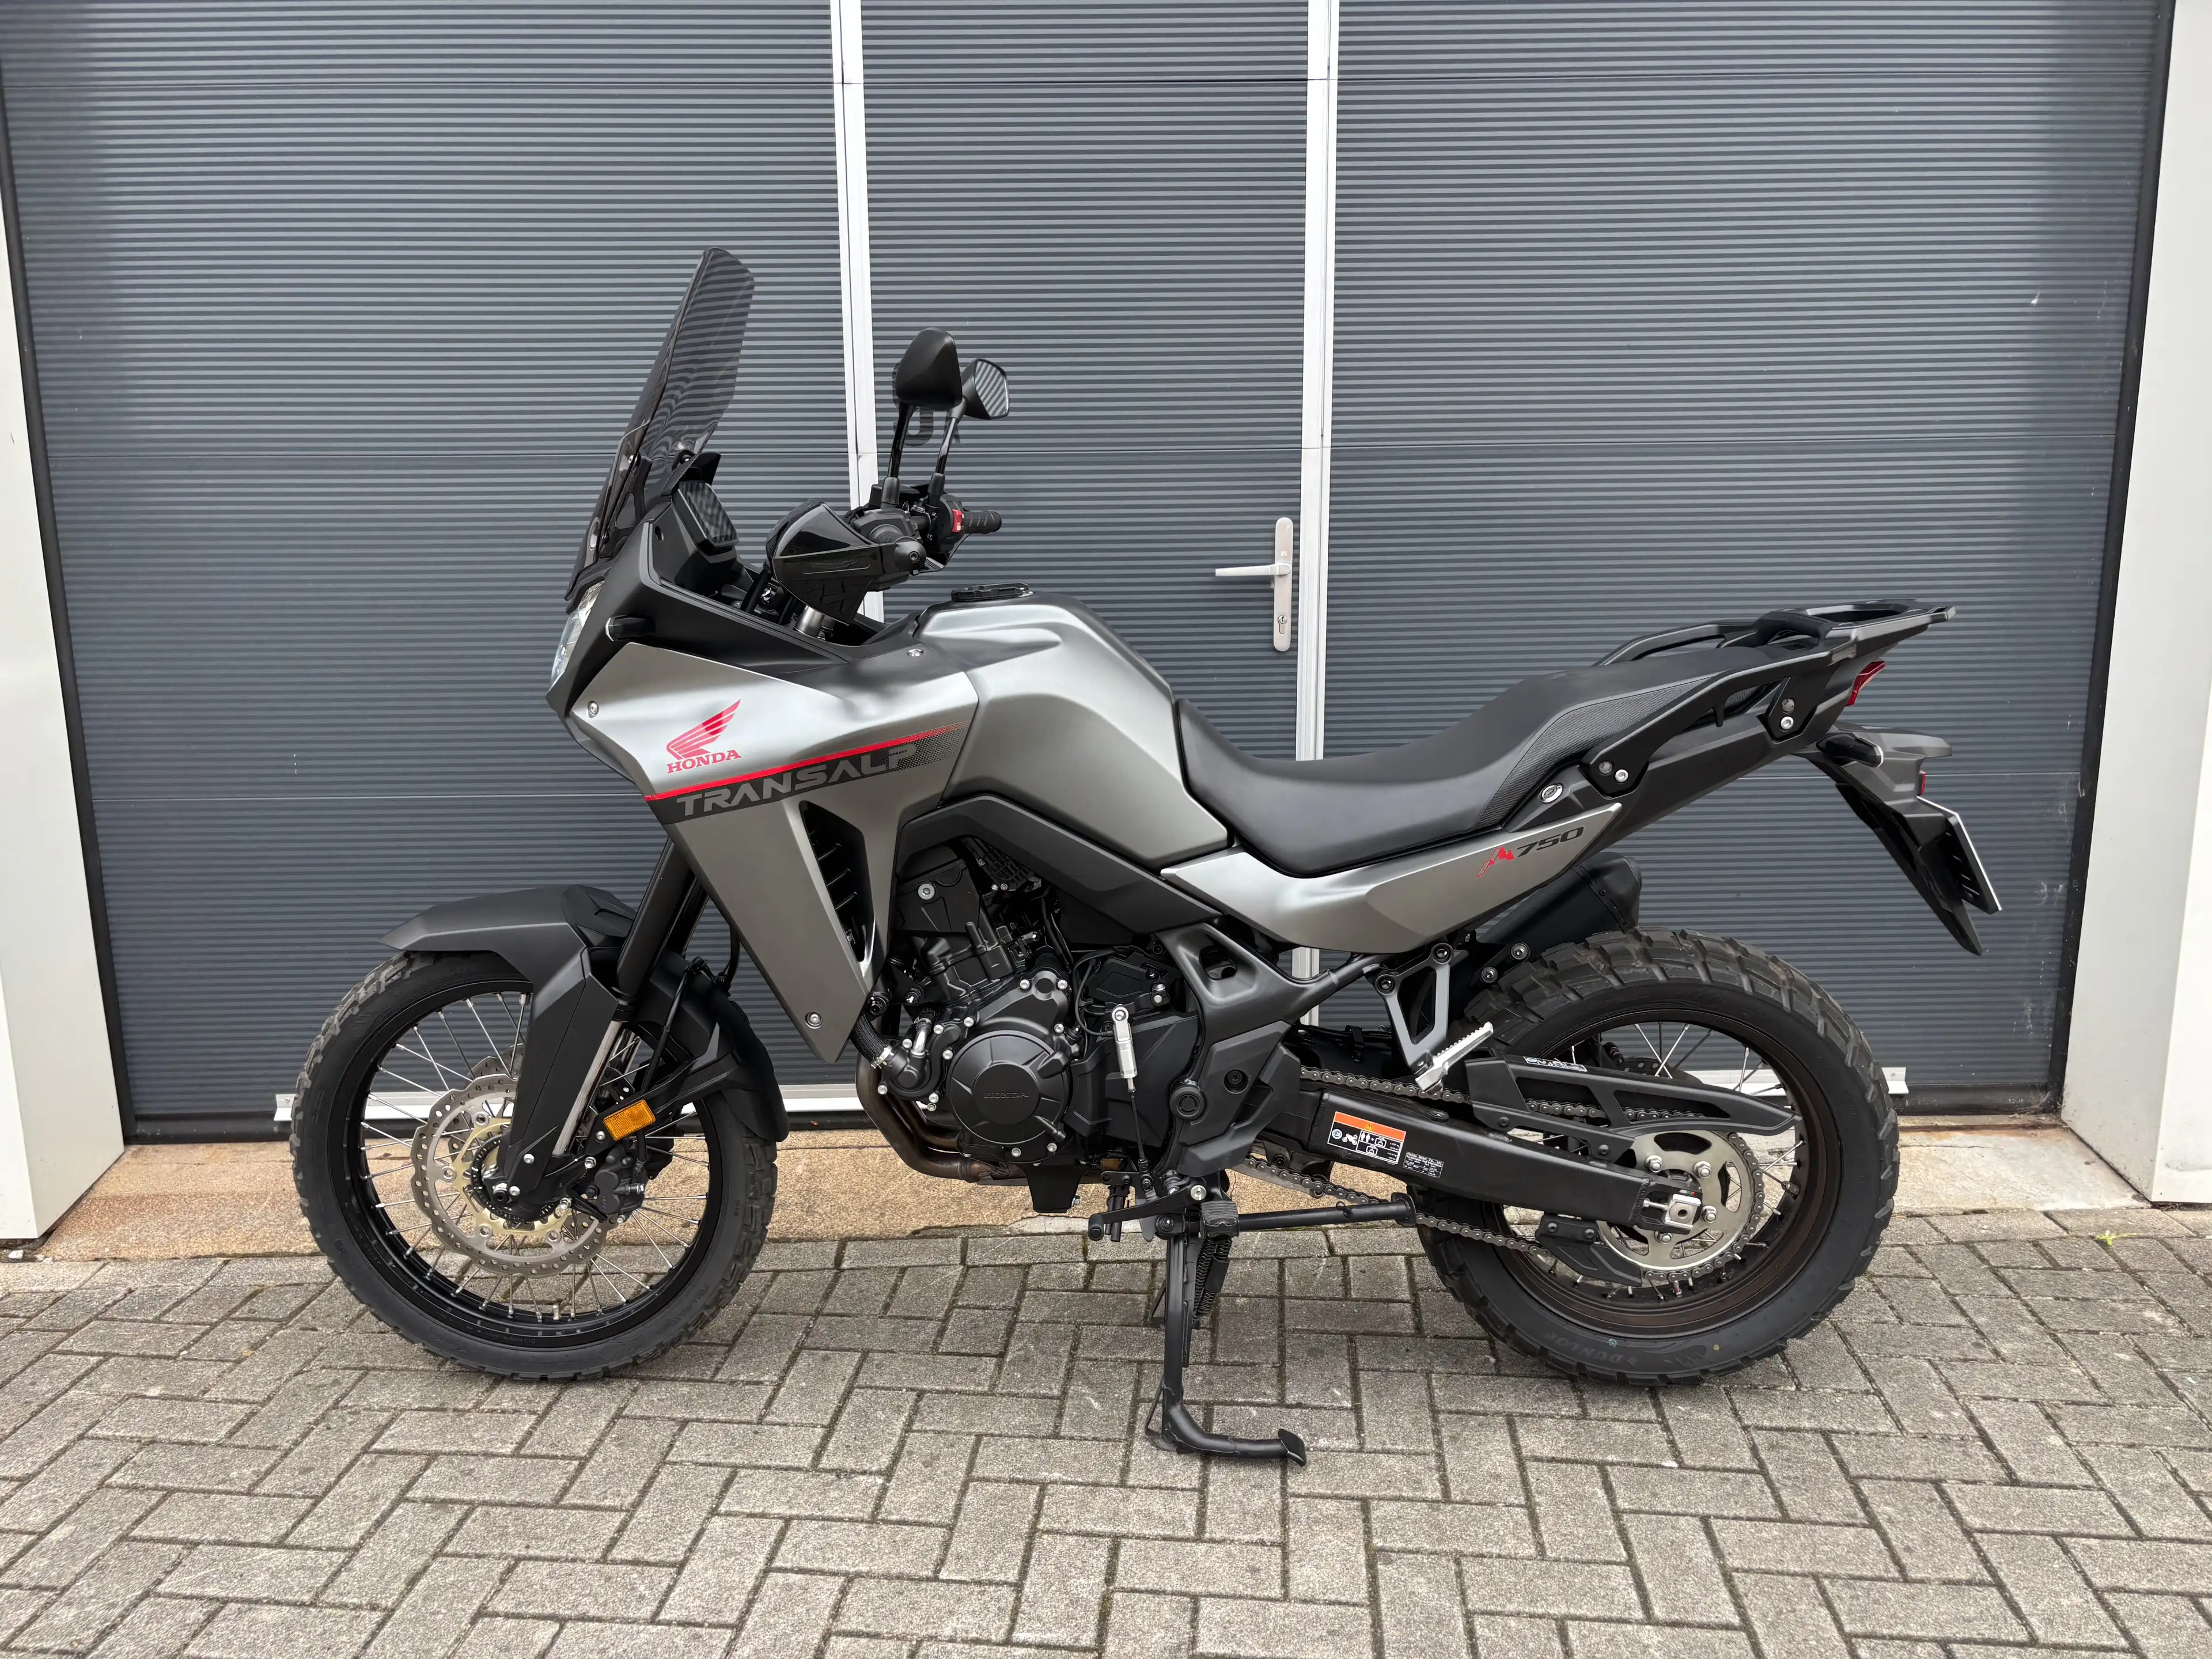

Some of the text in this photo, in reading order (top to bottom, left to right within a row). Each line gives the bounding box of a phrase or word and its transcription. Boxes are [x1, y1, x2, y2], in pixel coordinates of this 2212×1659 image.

[666, 749, 742, 774] HONDA
[676, 744, 916, 816] TRANSALP
[1517, 827, 1584, 857] 750
[1544, 1331, 1624, 1364] DUNLOP
